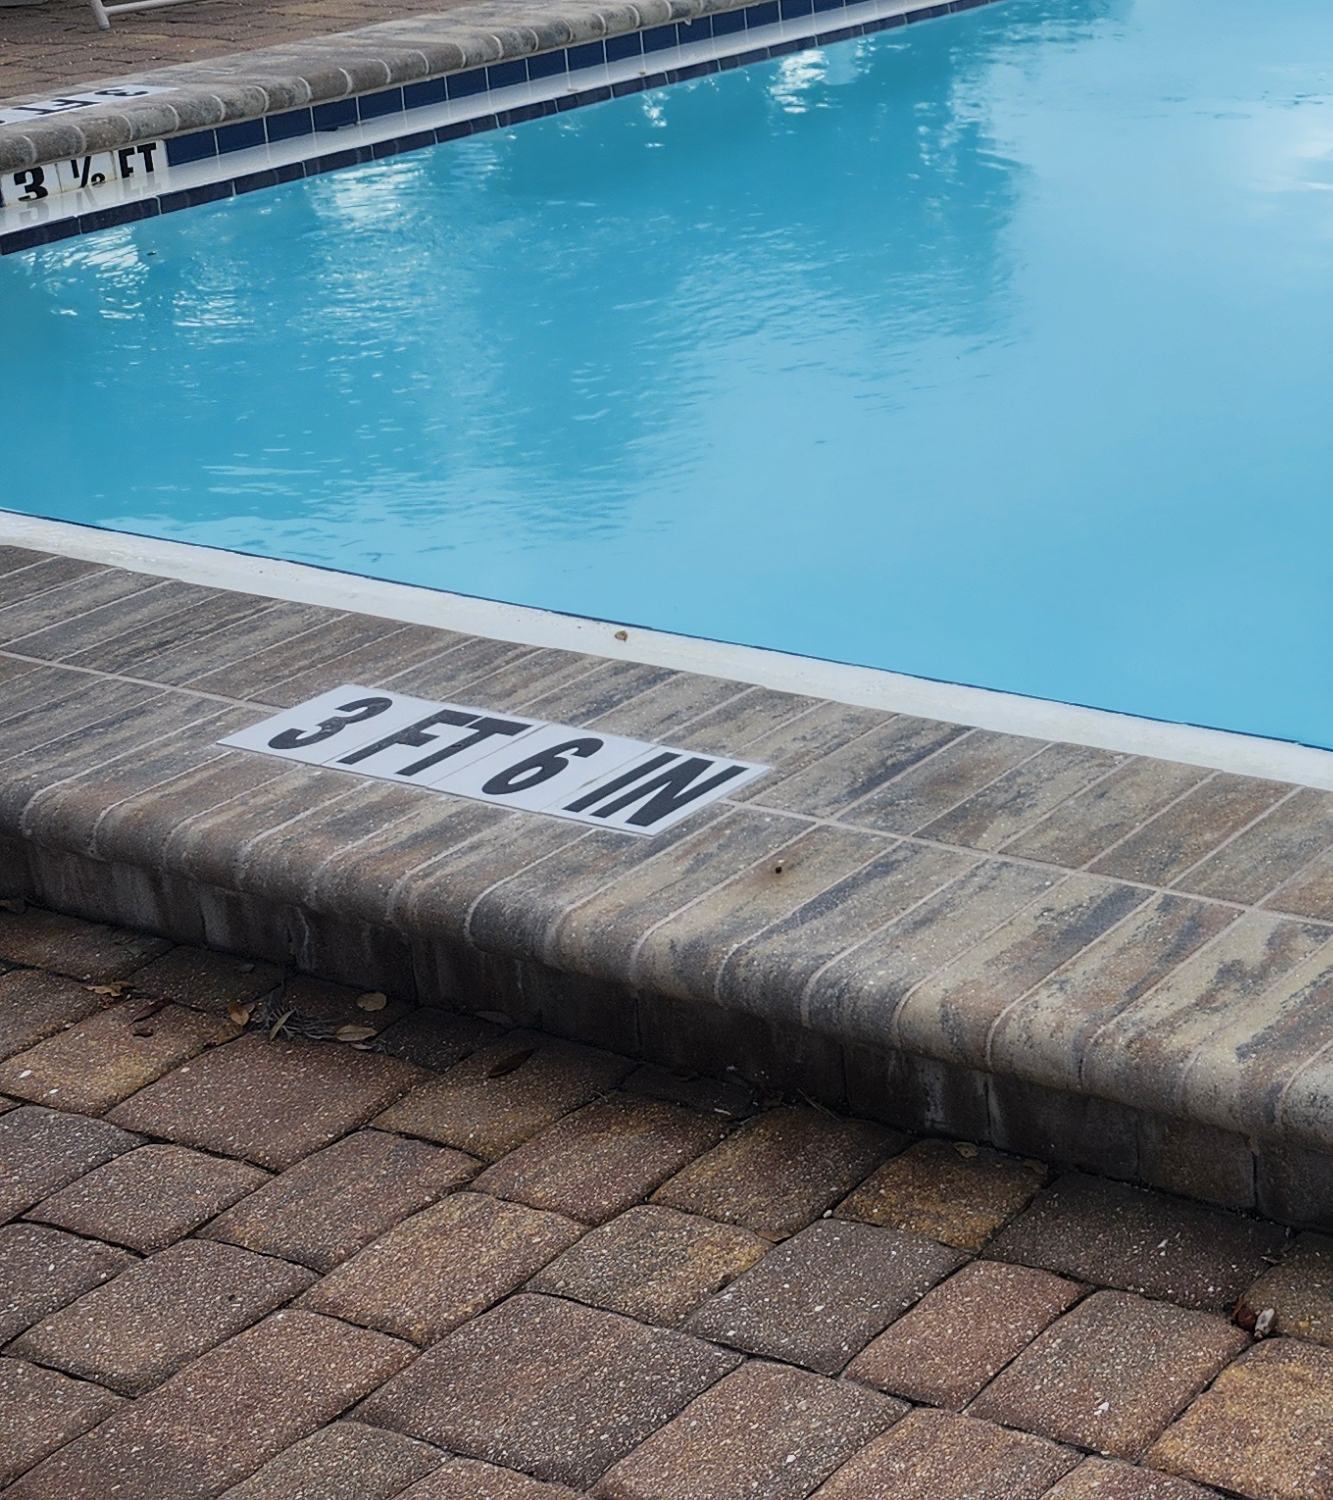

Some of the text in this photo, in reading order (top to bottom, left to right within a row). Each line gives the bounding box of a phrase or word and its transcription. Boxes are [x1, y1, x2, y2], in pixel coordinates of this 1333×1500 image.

[12, 98, 102, 115] FT
[14, 167, 48, 201] 3
[118, 142, 157, 179] FT
[268, 696, 750, 828] 3 FT 6 IN
